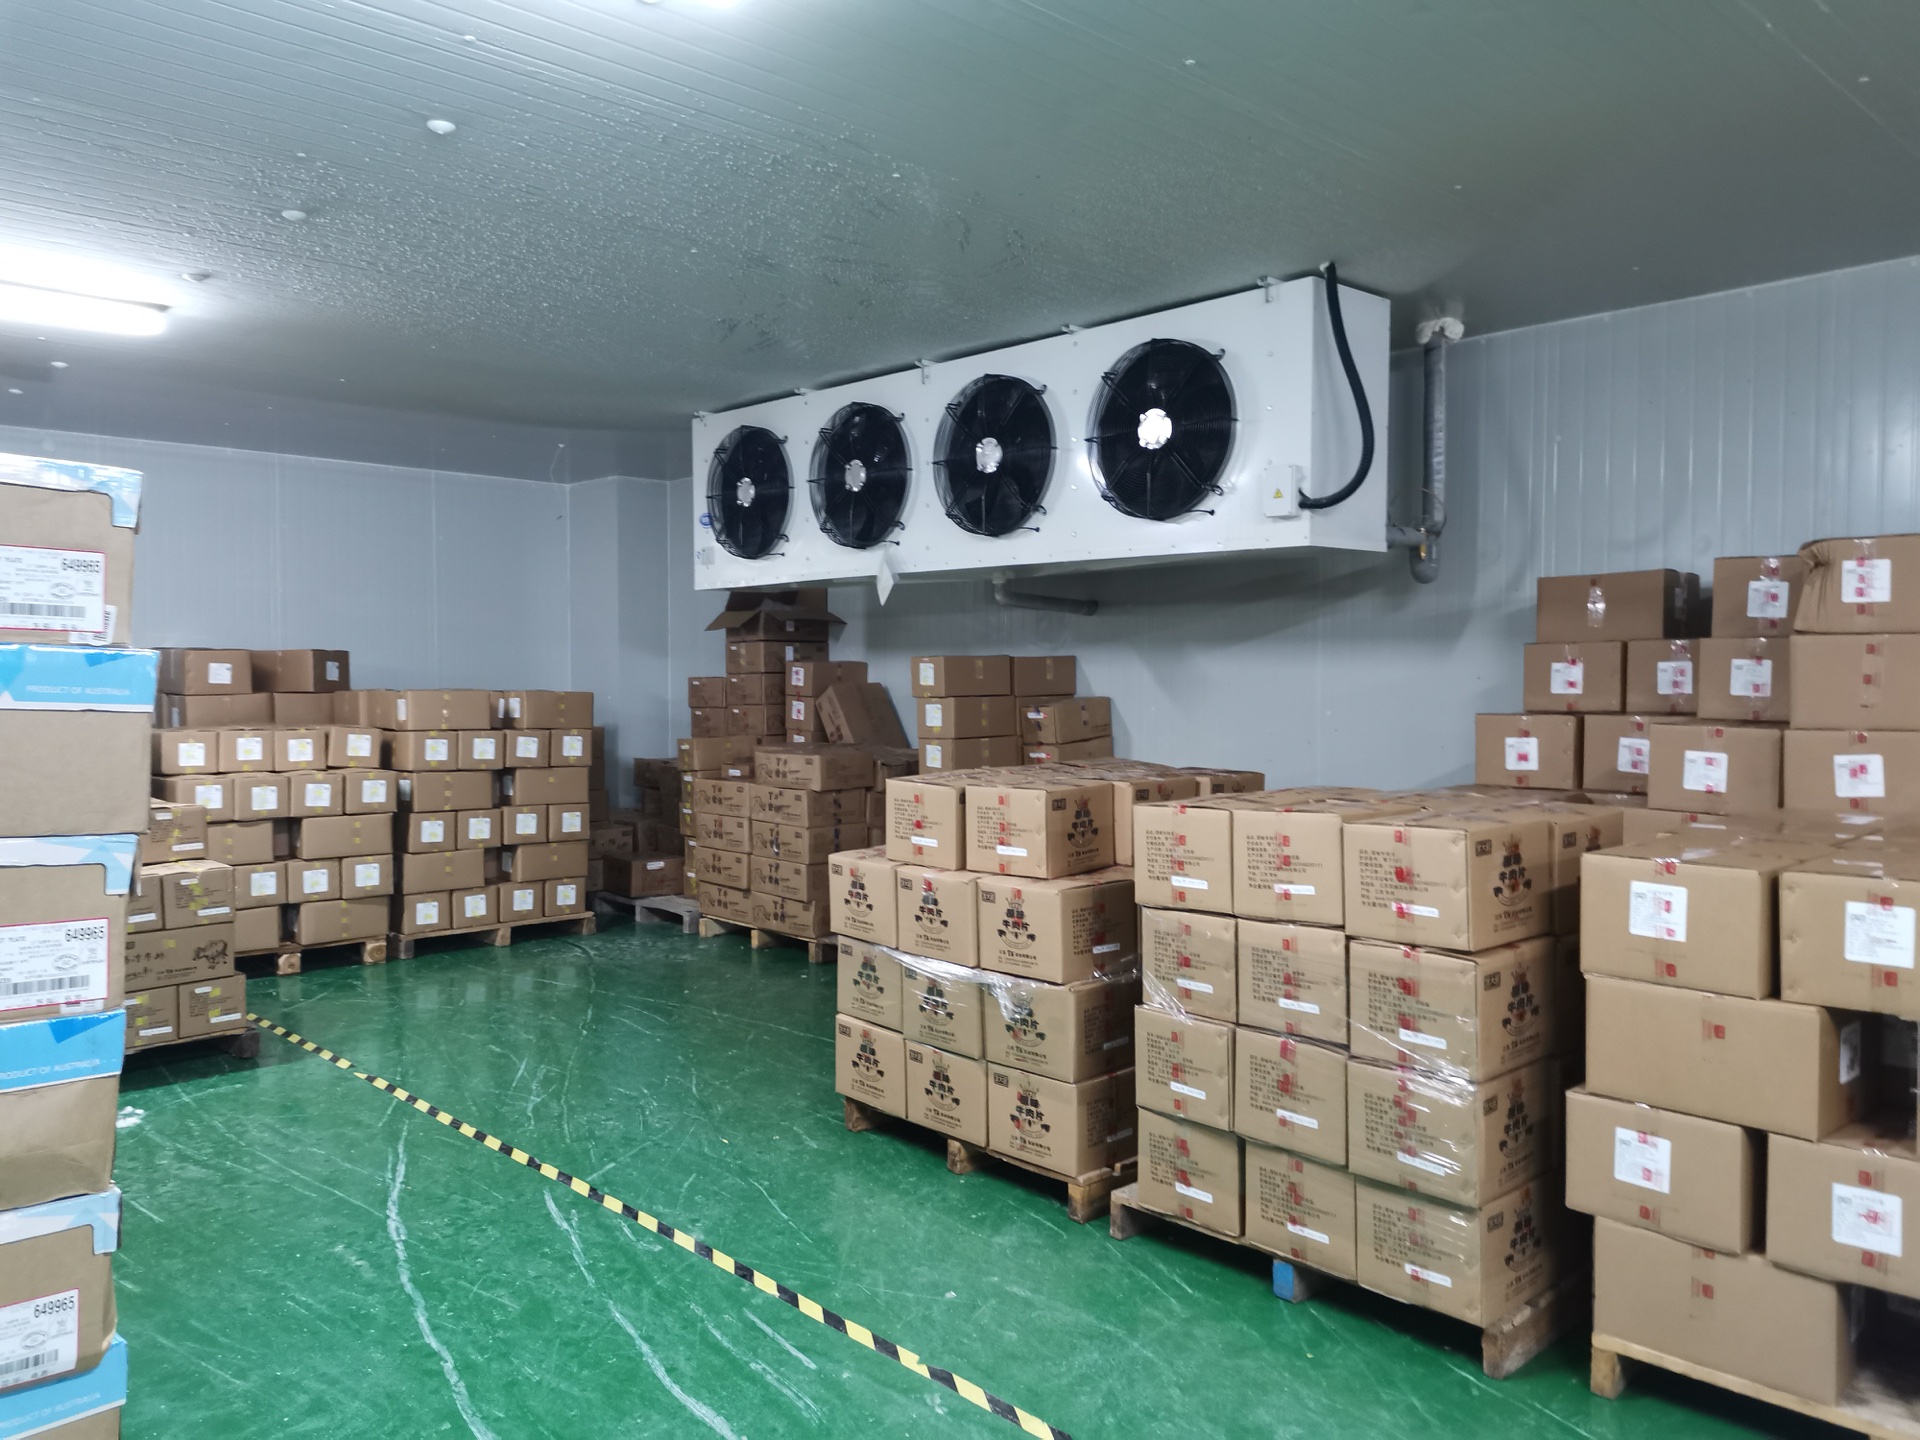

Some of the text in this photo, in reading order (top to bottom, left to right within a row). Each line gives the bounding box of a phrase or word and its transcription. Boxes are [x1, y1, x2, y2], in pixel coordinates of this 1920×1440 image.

[62, 557, 101, 574] 649965
[25, 684, 69, 694] PRODUCT
[71, 685, 83, 695] OF
[65, 926, 105, 943] 649965
[34, 1295, 75, 1318] 649965
